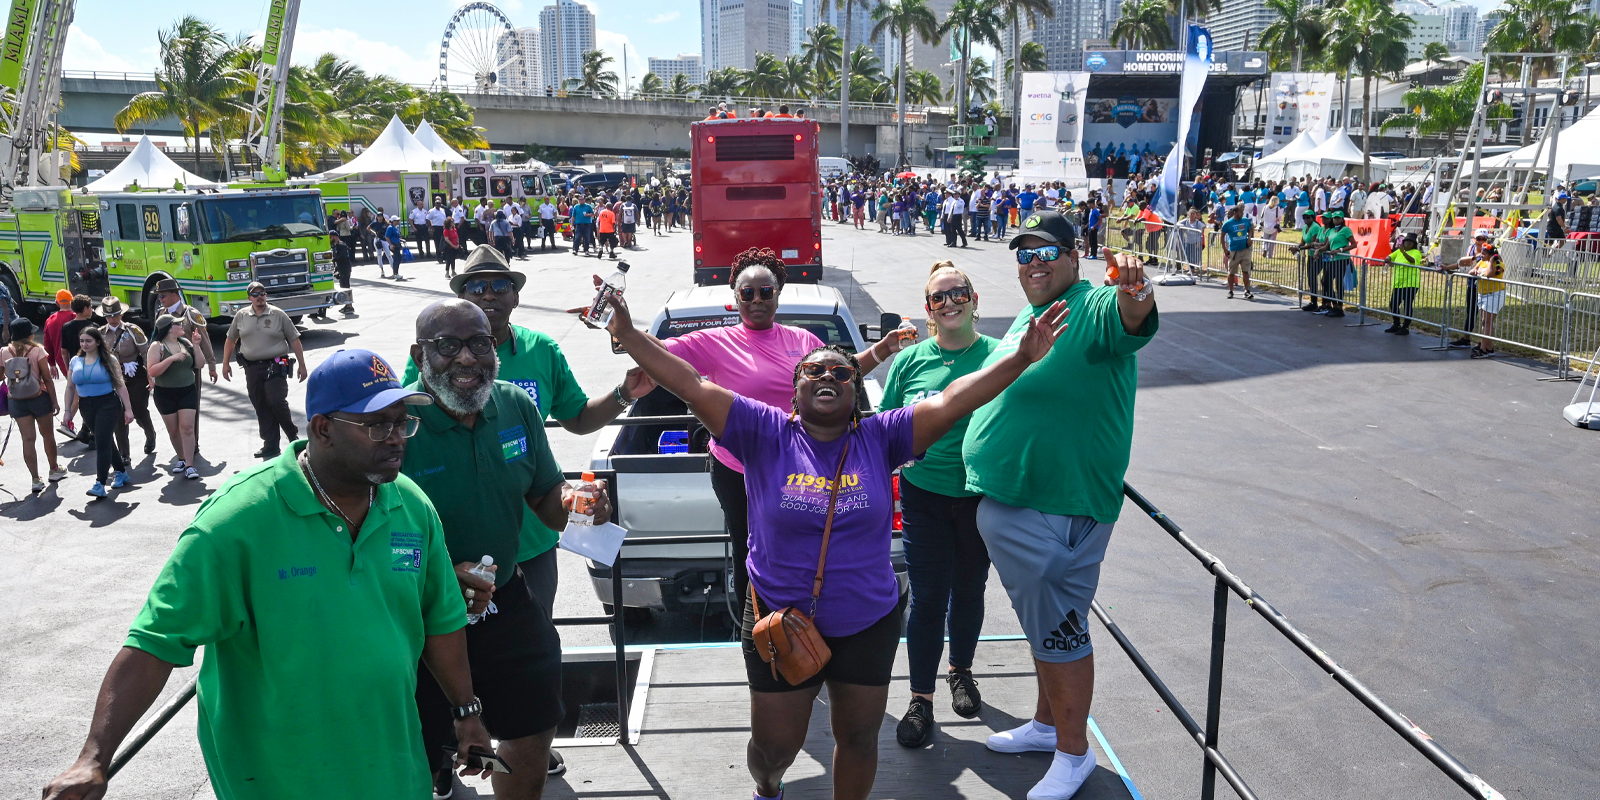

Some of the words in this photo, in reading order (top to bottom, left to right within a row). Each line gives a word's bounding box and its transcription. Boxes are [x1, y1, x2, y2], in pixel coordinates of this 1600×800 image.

[1030, 113, 1052, 121] CMG
[145, 211, 160, 233] 29
[669, 320, 699, 329] POWER
[701, 317, 722, 326] TOUR
[786, 473, 859, 490] 1199SIU
[782, 494, 822, 505] QUALITY
[824, 498, 844, 507] CE
[846, 493, 868, 504] AND
[780, 501, 808, 512] GOOD
[809, 507, 828, 515] JOB
[834, 505, 850, 515] OR
[853, 501, 871, 510] ALL
[291, 566, 317, 577] Orange
